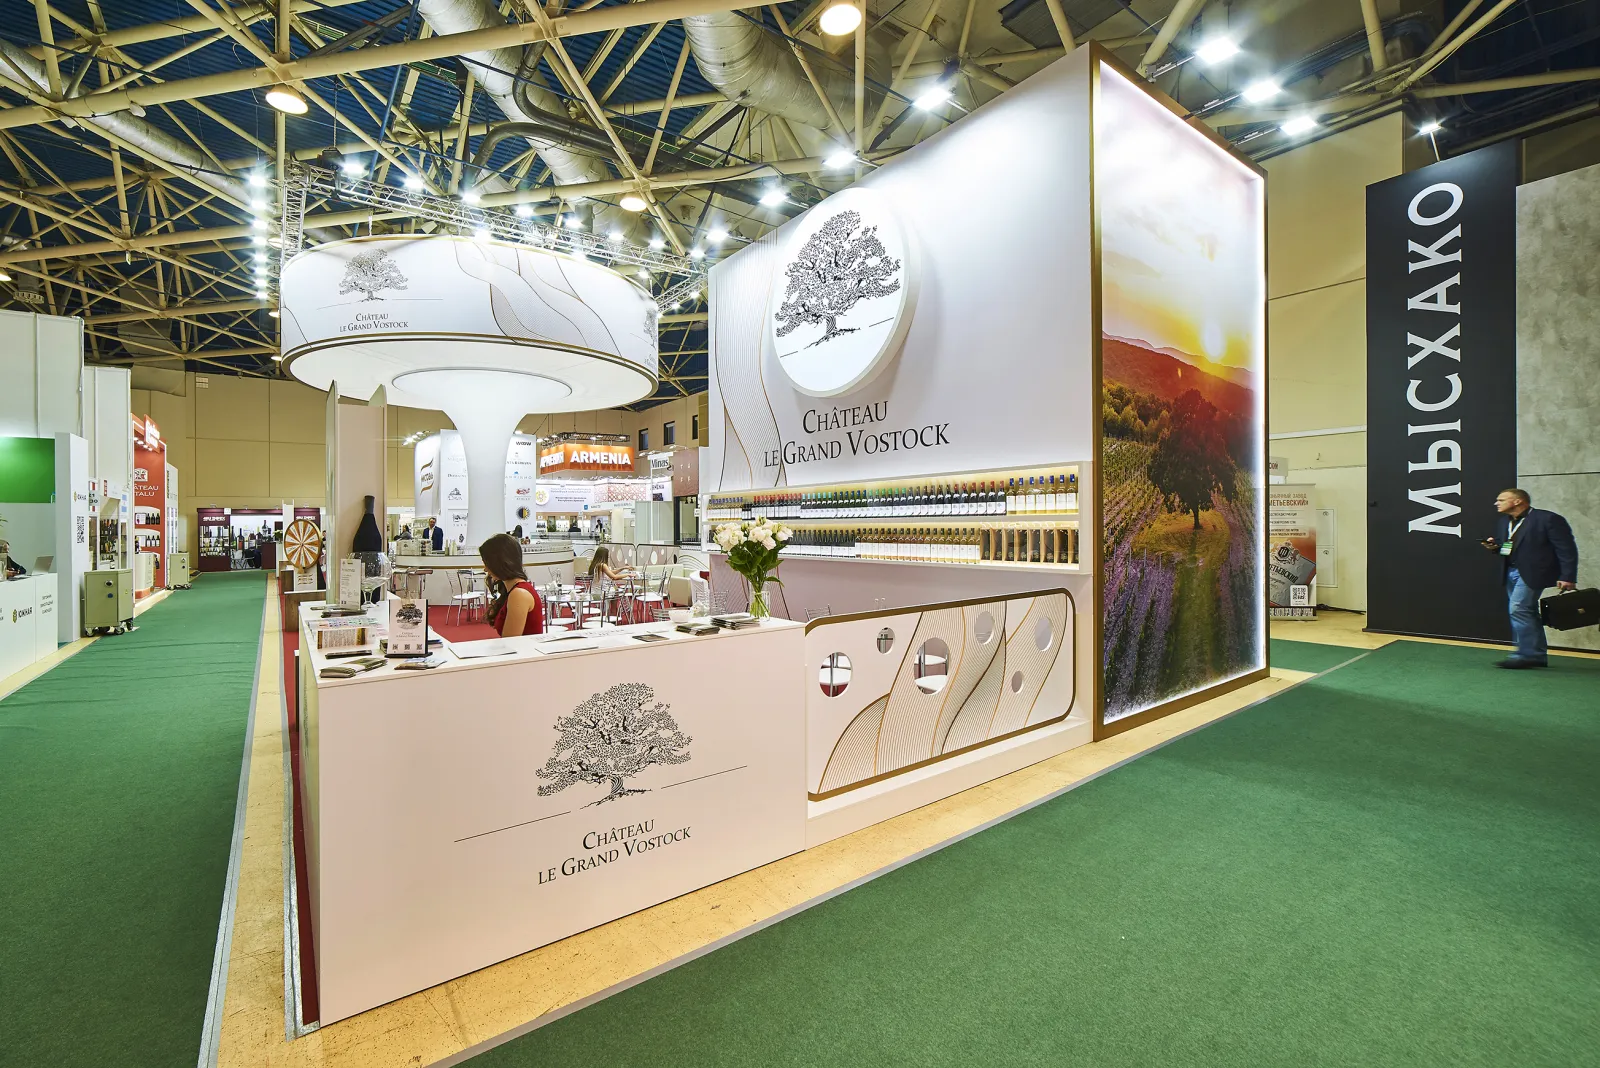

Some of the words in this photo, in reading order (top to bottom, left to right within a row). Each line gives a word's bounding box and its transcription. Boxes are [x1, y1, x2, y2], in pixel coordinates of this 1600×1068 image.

[347, 322, 372, 331] GRAND
[373, 320, 409, 329] VOSTOCK
[1406, 182, 1464, 538] МЫСХАКО
[802, 400, 889, 434] CHÂTEAU
[570, 450, 631, 464] ARMENIA
[764, 450, 780, 468] LE
[783, 440, 842, 465] GRAND
[846, 422, 950, 456] VOSTOCK
[582, 819, 655, 850] CHÂTEAU
[538, 867, 557, 885] LE
[561, 849, 619, 876] GRAND
[623, 826, 692, 857] VOSTOCK
